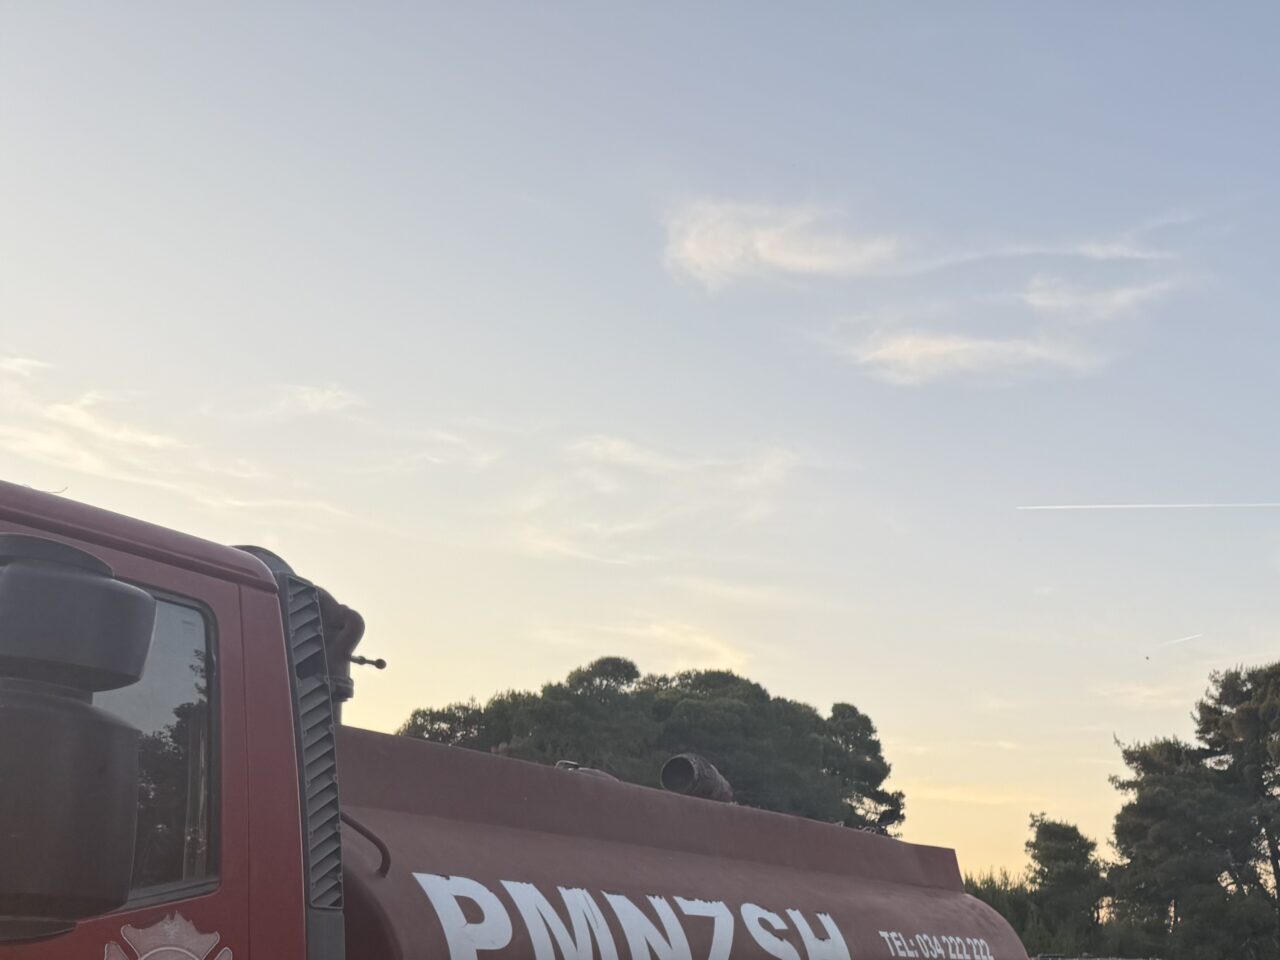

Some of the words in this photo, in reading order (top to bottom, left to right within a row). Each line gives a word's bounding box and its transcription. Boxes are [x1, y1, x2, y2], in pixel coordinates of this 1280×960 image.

[878, 930, 920, 958] TEL:
[915, 933, 946, 960] 034
[942, 935, 972, 960] 222
